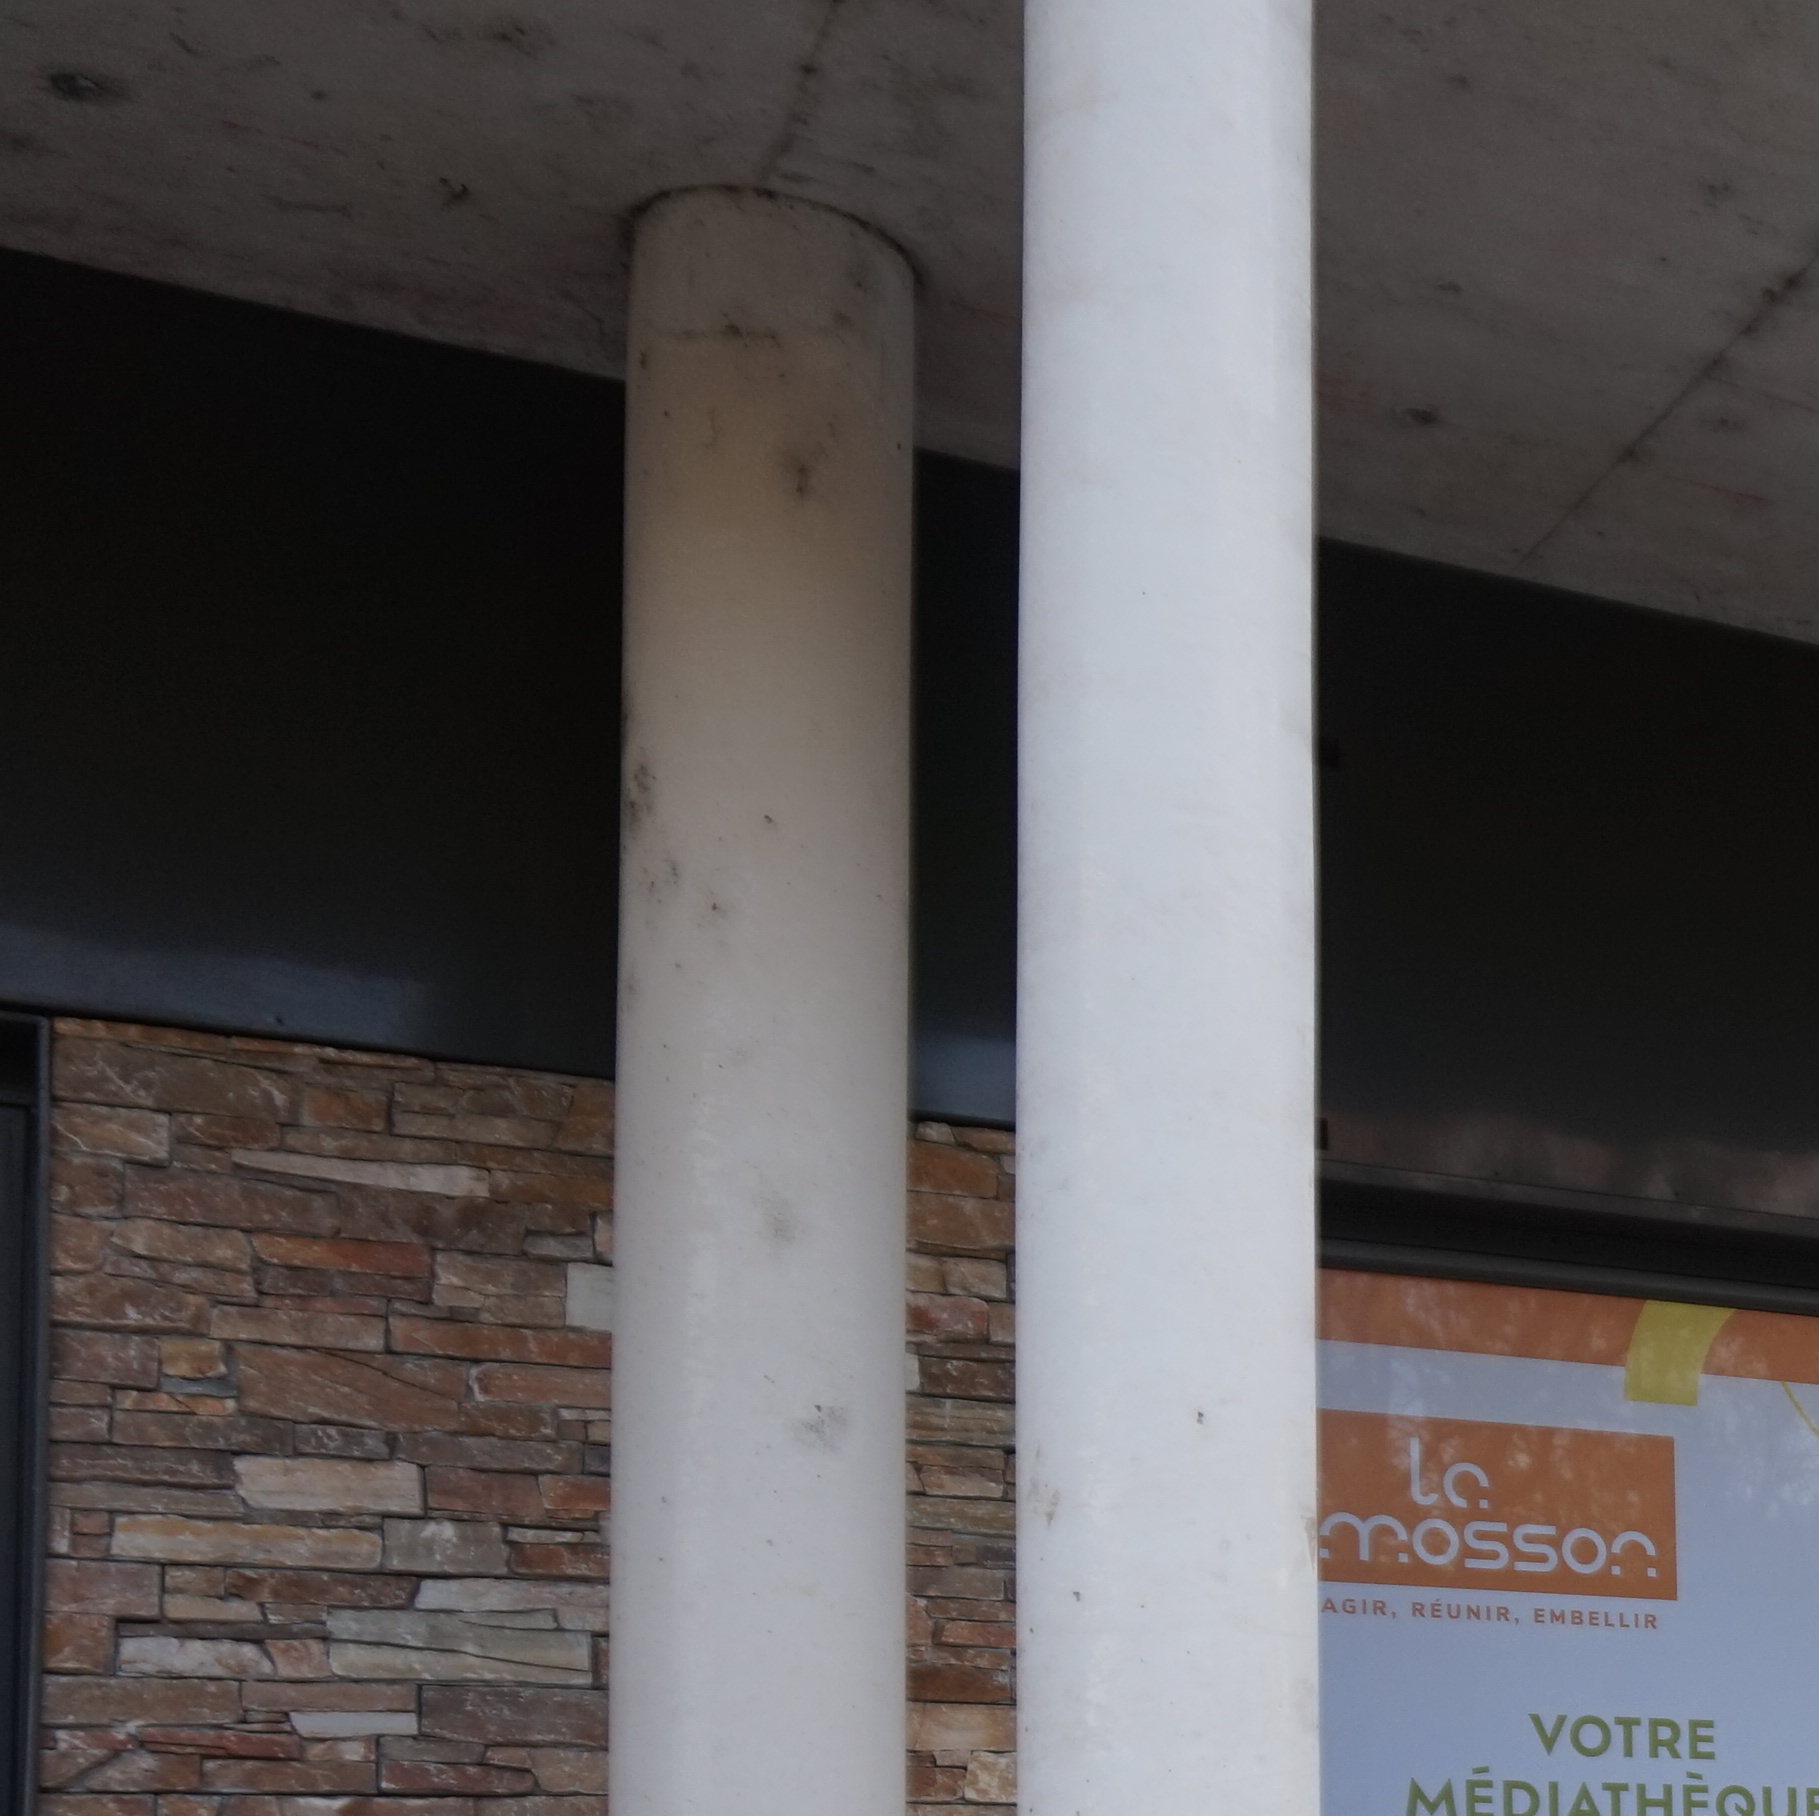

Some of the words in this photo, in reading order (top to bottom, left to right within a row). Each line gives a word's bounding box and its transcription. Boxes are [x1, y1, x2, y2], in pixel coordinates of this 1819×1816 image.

[1410, 1437, 1489, 1509] la
[1321, 1596, 1397, 1619] AGIR,
[1411, 1598, 1520, 1625] RÉUNIR,
[1533, 1607, 1657, 1629] EMBELLIR
[1528, 1713, 1715, 1760] VOTRE
